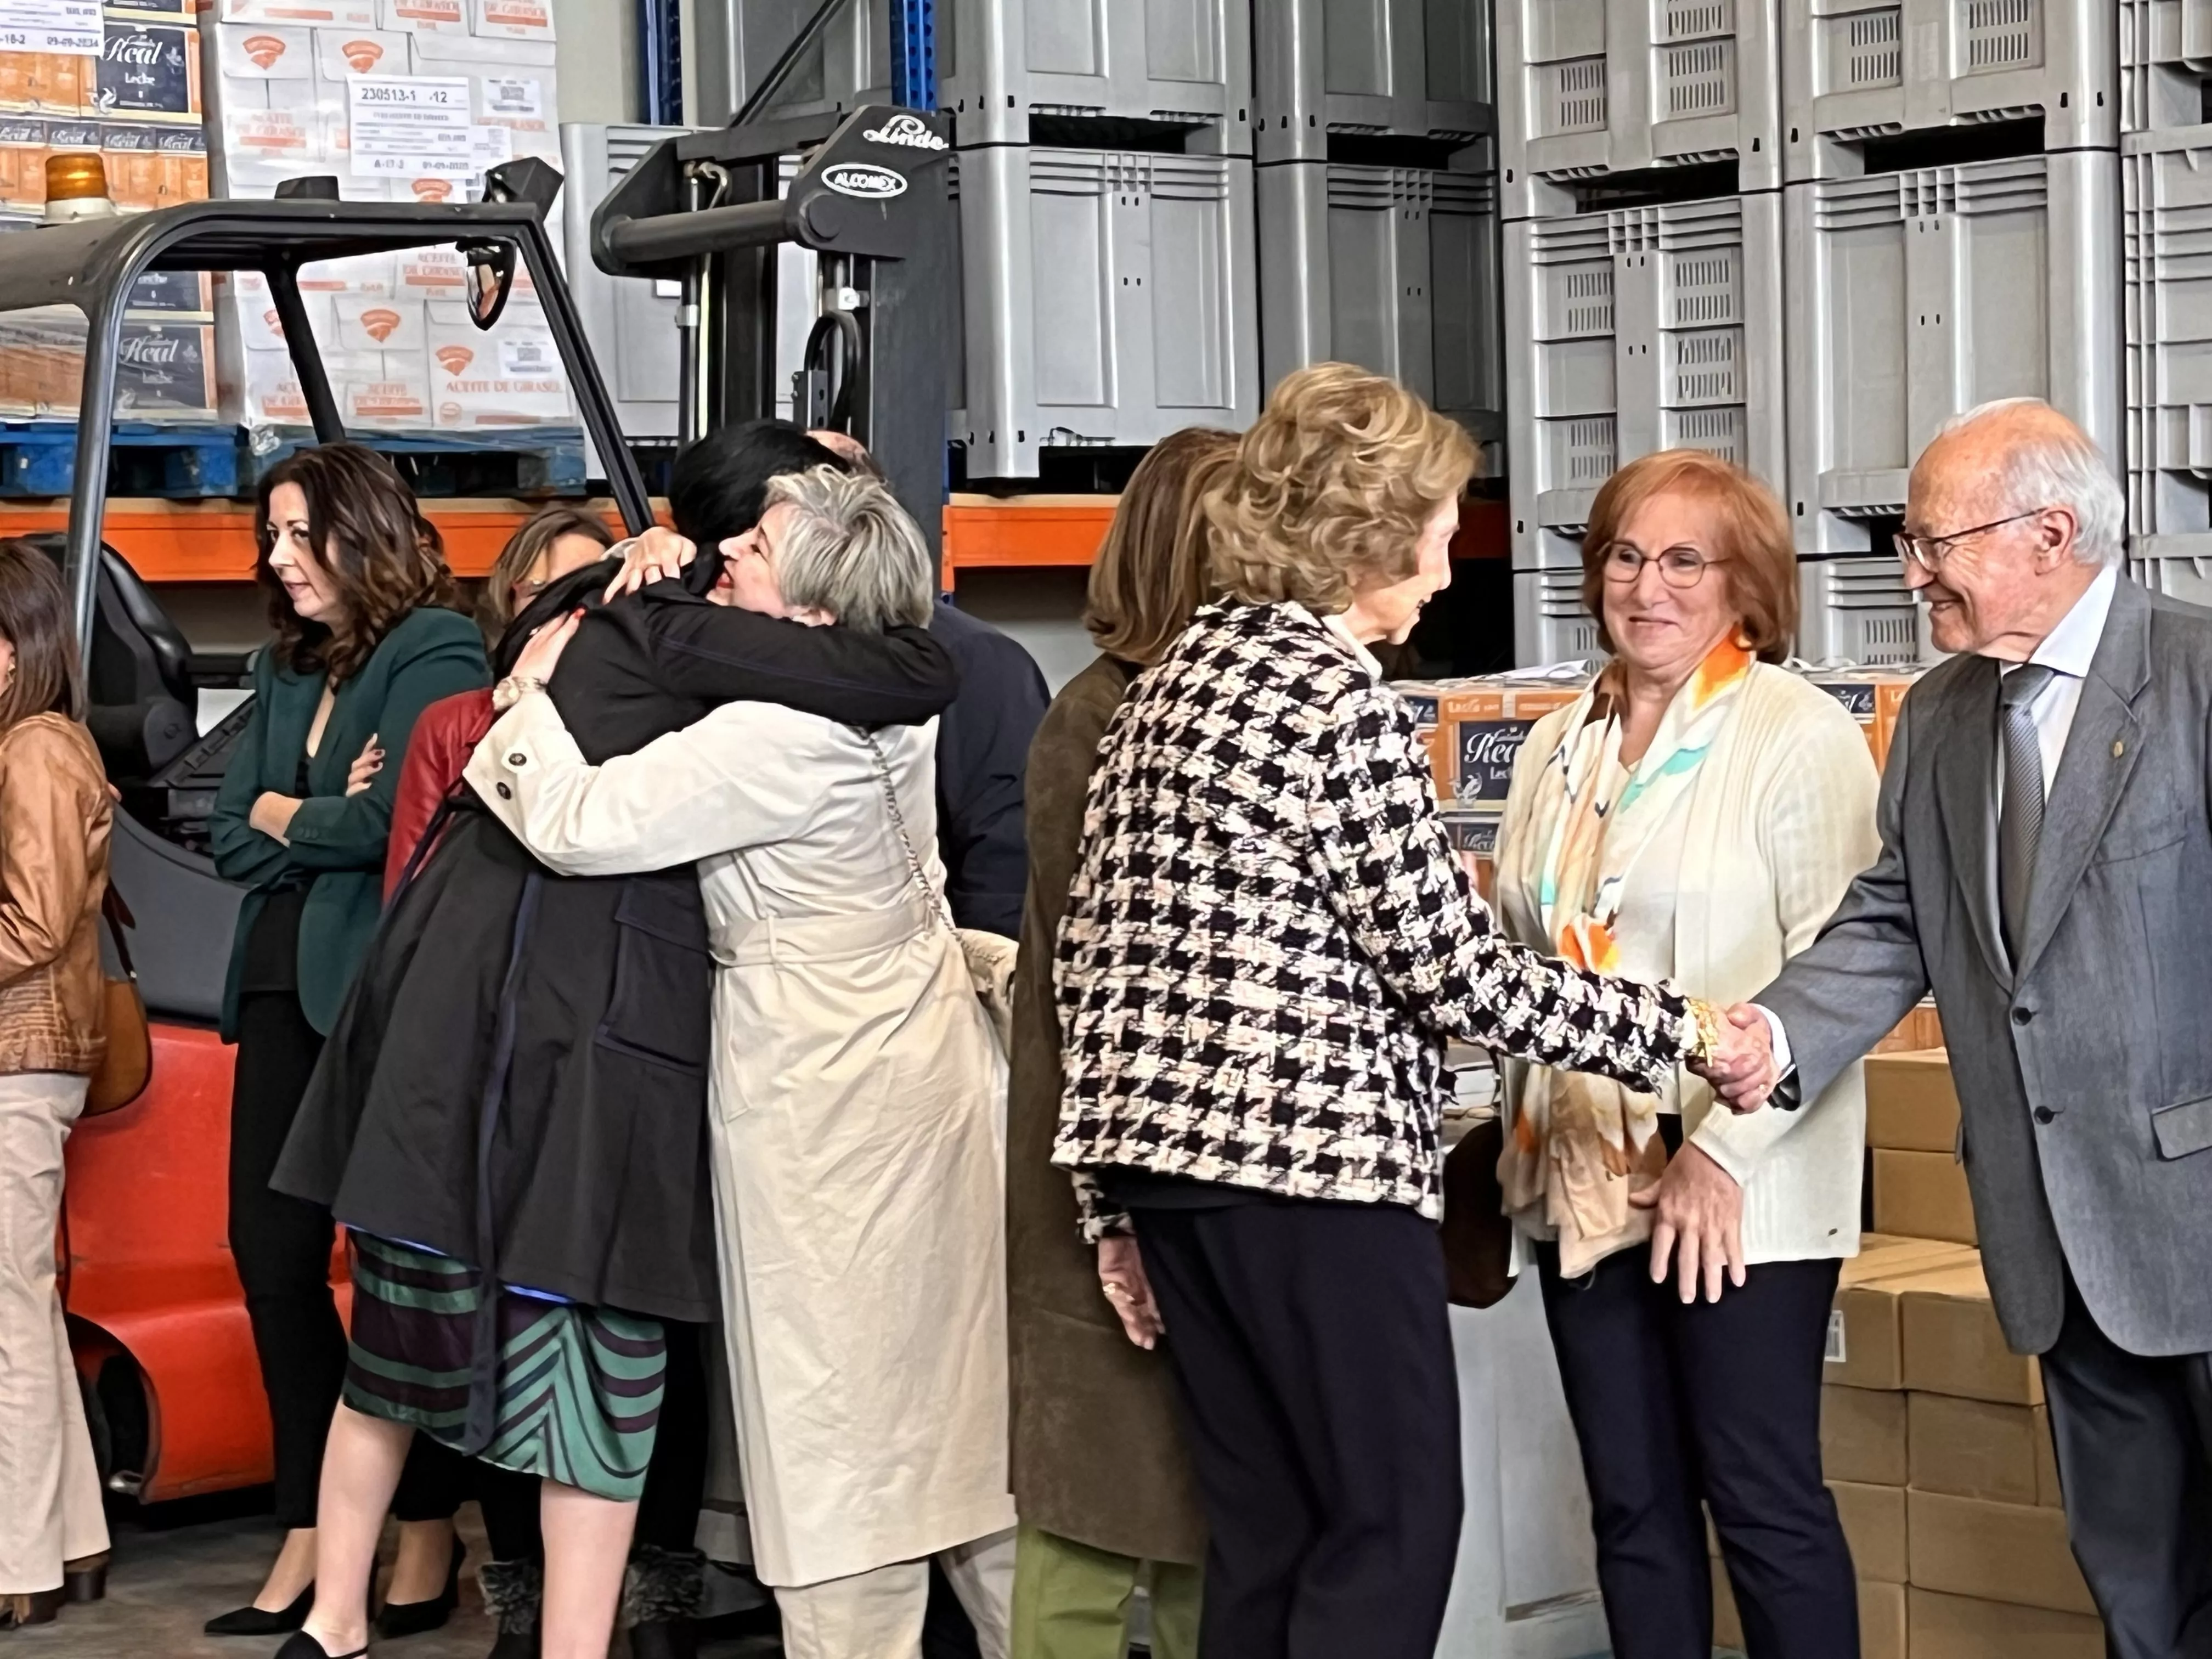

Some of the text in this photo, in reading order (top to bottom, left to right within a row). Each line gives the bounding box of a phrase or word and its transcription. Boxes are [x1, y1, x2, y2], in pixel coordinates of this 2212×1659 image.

[862, 114, 950, 151] Linde
[445, 381, 490, 393] ACEITE
[493, 381, 510, 393] DE
